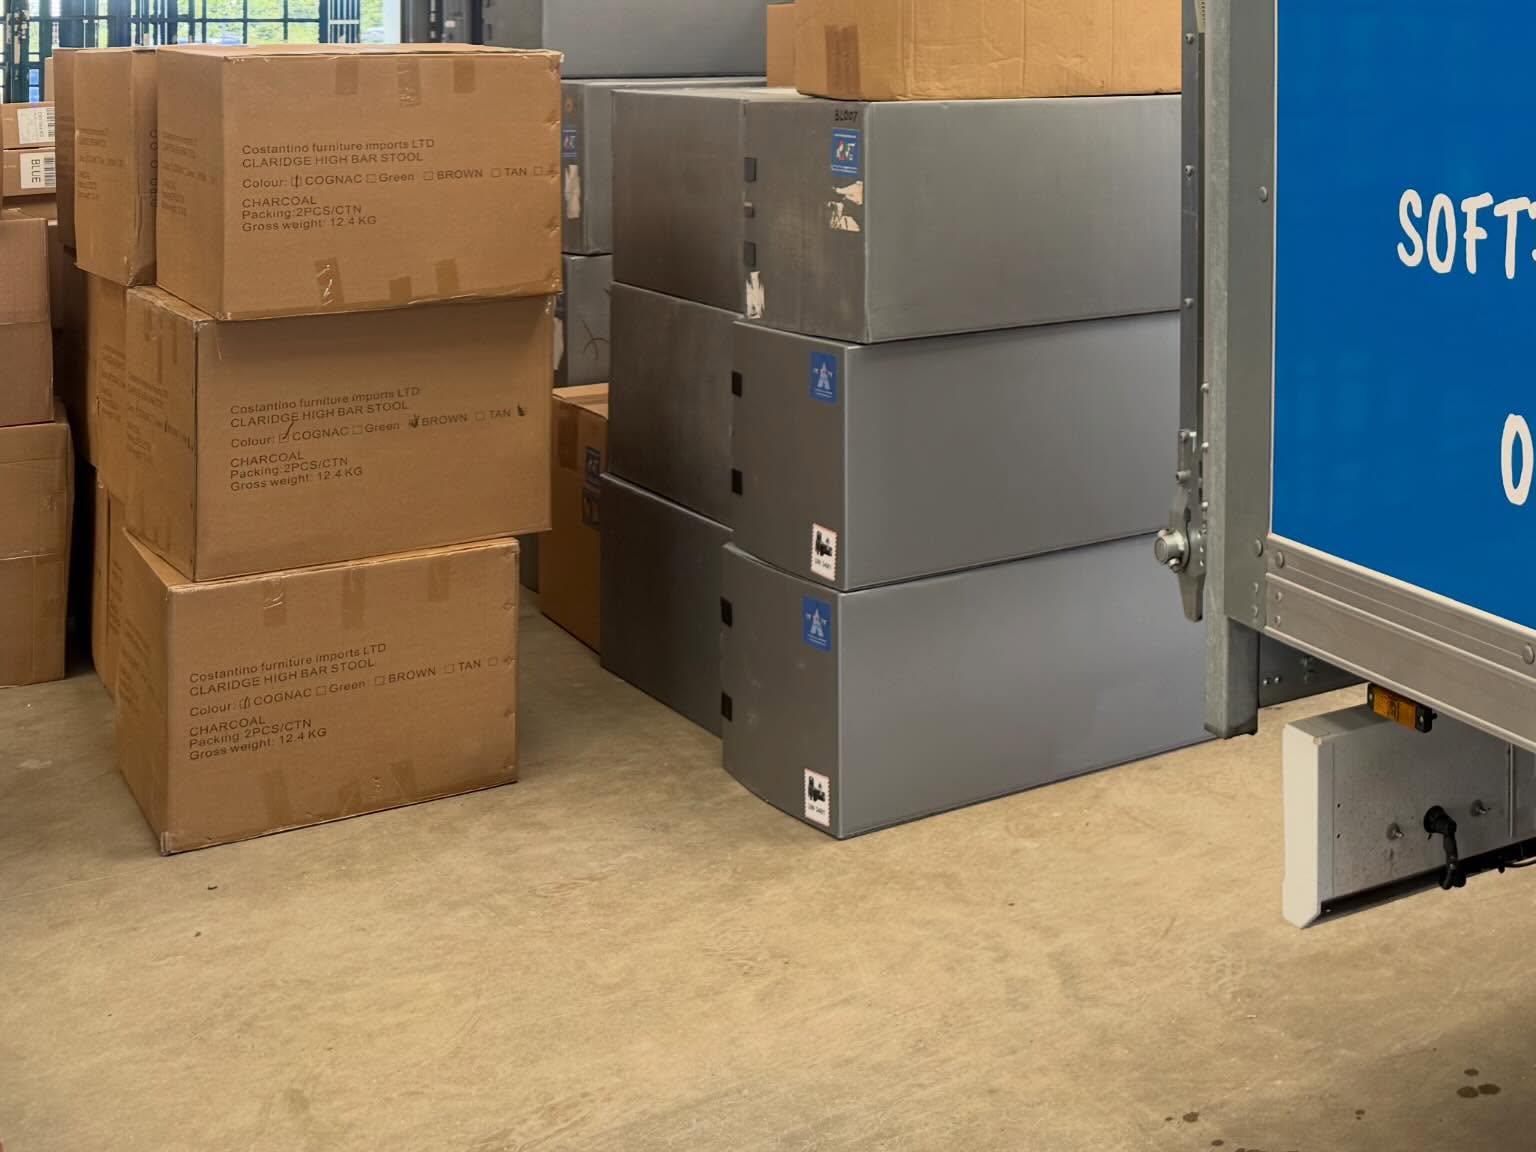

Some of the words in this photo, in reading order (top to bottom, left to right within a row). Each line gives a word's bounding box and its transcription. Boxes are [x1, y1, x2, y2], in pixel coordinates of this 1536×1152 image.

[242, 144, 310, 156] Costantino
[312, 141, 363, 153] furniture
[366, 139, 409, 152] imports
[411, 138, 435, 148] LTD
[31, 159, 41, 184] BLUE
[242, 156, 312, 168] CLARIDGE
[315, 154, 348, 165] HIGH
[351, 153, 378, 164] BAR
[380, 152, 424, 163] STOOL
[305, 174, 363, 186] COGNAC
[379, 171, 415, 183] Green
[437, 169, 483, 181] BROWN
[504, 166, 527, 177] TAN
[242, 195, 317, 209] CHARCOAL
[242, 222, 280, 233] Gross
[358, 215, 377, 226] KG
[230, 400, 297, 415] Costantino
[299, 393, 349, 408] furniture
[352, 389, 395, 404] imports
[397, 386, 421, 398] LTD
[230, 412, 300, 429] CLARIDGE
[302, 408, 336, 422] HIGH
[337, 404, 364, 417] BAR
[366, 400, 410, 413] STOOL
[292, 426, 350, 441] COGNAC
[364, 421, 400, 433] Green
[421, 413, 468, 426] BROWN
[489, 408, 511, 420] TAN
[230, 451, 305, 468] CHARCOAL
[230, 481, 268, 492] Gross
[345, 466, 363, 477] KG
[189, 665, 258, 684] Costantino
[261, 658, 313, 674] furniture
[316, 648, 361, 666] imports
[363, 643, 387, 657] LTD
[189, 678, 261, 698] CLARIDGE
[264, 669, 298, 685] HIGH
[300, 664, 329, 679] BAR
[331, 657, 375, 674] STOOL
[253, 687, 313, 706] COGNAC
[329, 680, 366, 694] Green
[388, 666, 437, 685] BROWN
[458, 659, 482, 673] TAN
[189, 715, 267, 738] CHARCOAL
[189, 749, 228, 762] Gross
[308, 727, 328, 742] KG
